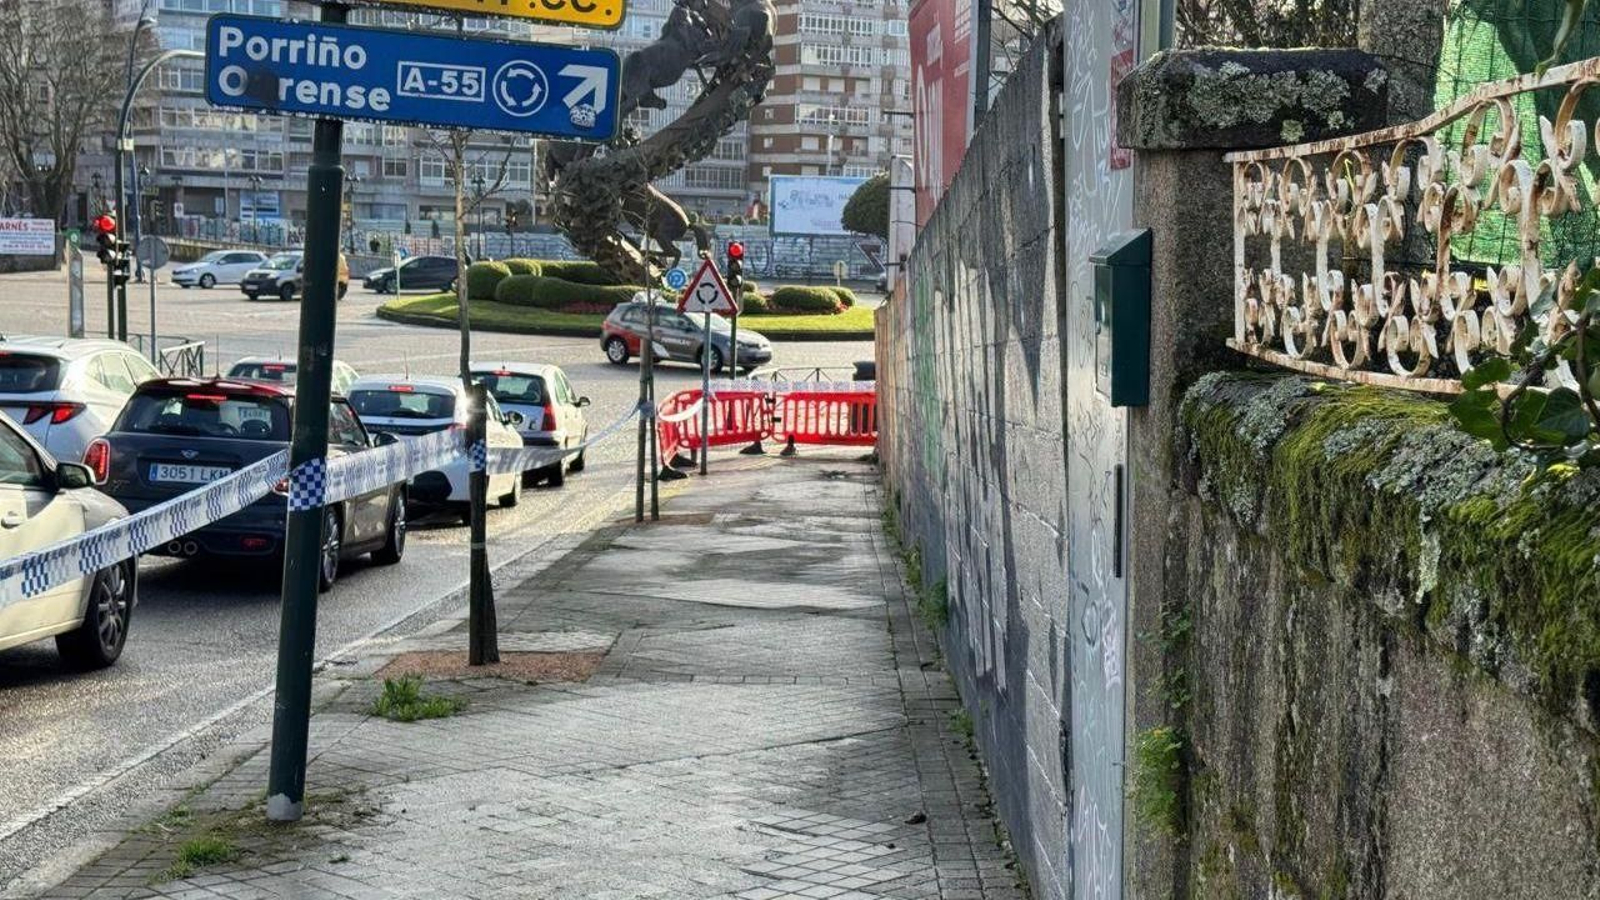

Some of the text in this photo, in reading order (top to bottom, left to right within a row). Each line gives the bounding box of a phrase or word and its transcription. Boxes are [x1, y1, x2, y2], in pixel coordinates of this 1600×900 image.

[219, 25, 367, 70] Porriño
[218, 64, 391, 111] Orense
[403, 67, 480, 96] A-55
[160, 466, 195, 480] 3051
